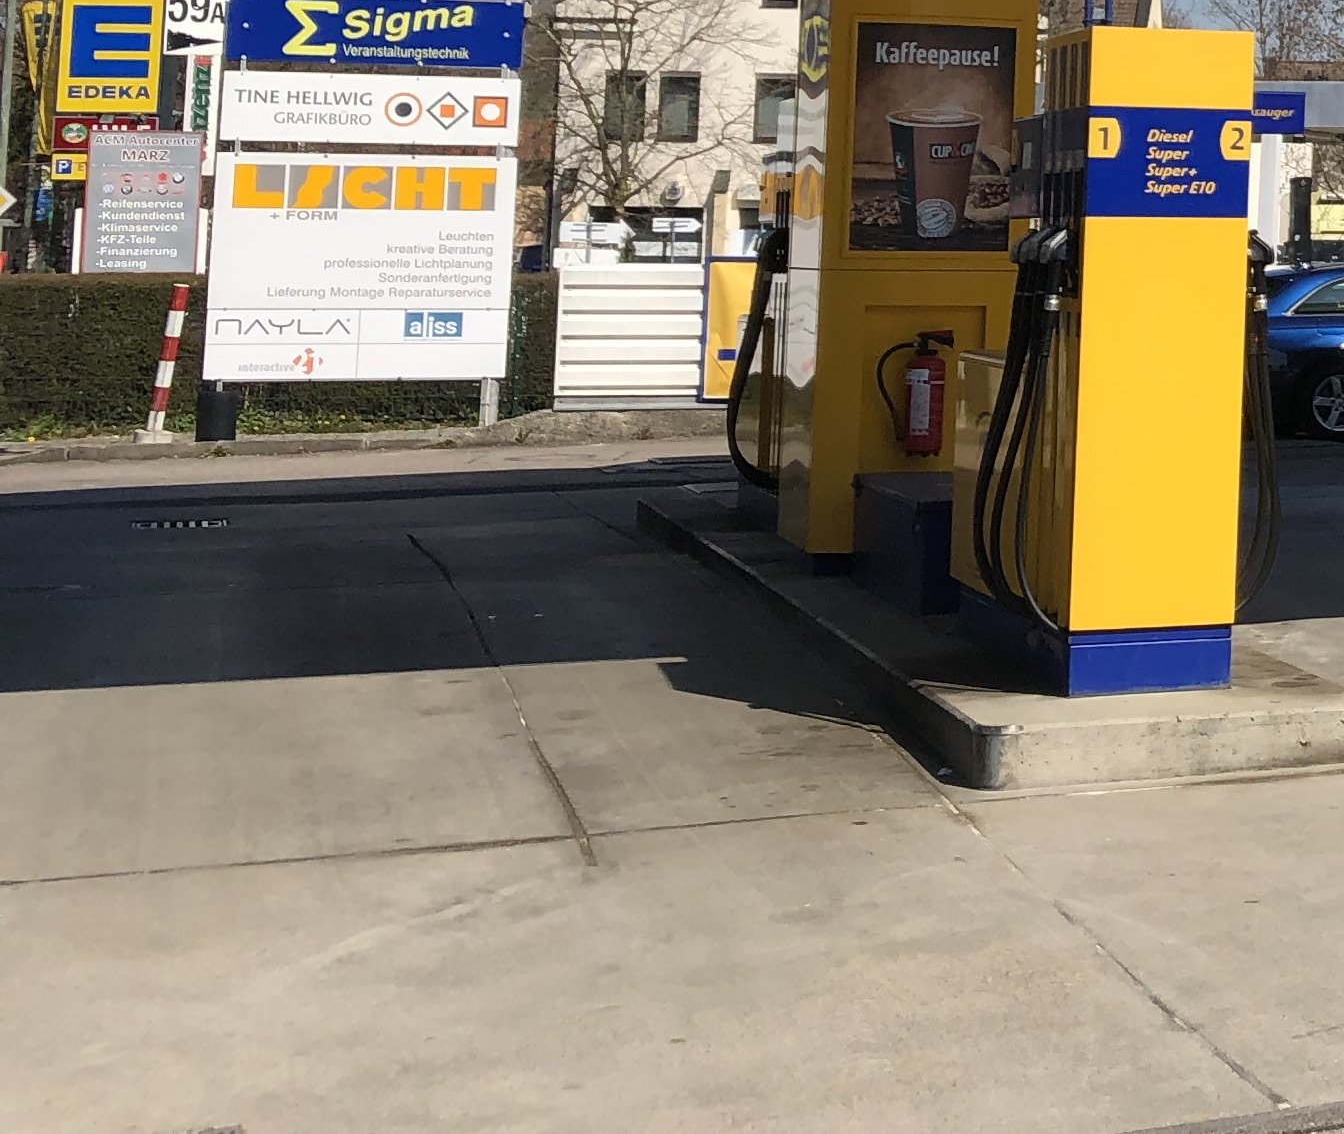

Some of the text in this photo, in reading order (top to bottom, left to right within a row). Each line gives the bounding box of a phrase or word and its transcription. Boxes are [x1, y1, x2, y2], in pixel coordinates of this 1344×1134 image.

[342, 4, 474, 42] Sigma
[342, 43, 470, 60] Veranstaltungstechnik
[875, 42, 1000, 71] Kaffeepause!
[67, 85, 150, 99] EDEKA
[235, 88, 373, 107] TINE HELLWIG
[273, 110, 372, 126] GRAFIKBÜRO
[94, 135, 200, 146] ACM Autocenter
[1098, 127, 1109, 150] 1
[1146, 129, 1194, 144] Diesel
[1229, 127, 1245, 151] 2
[121, 149, 171, 163] MARZ
[1145, 147, 1190, 163] Super
[1145, 164, 1198, 180] Super+
[1144, 181, 1217, 197] Super E10
[98, 199, 184, 209] -Reifenservice
[98, 211, 185, 221] -Kundendienst
[285, 211, 338, 221] FORM
[97, 223, 179, 233] -Klimaservice
[97, 235, 157, 244] -KFZ-Teile
[438, 231, 494, 241] Leuchten
[96, 247, 178, 257] -Finanzierung
[386, 244, 494, 257] kreative Beratung
[95, 259, 147, 270] -Leasing
[323, 258, 493, 271] professionelle Lichtplanung
[378, 273, 492, 285] Sonderanfertigung
[266, 287, 492, 300] Lieferung Montage Reparaturservice
